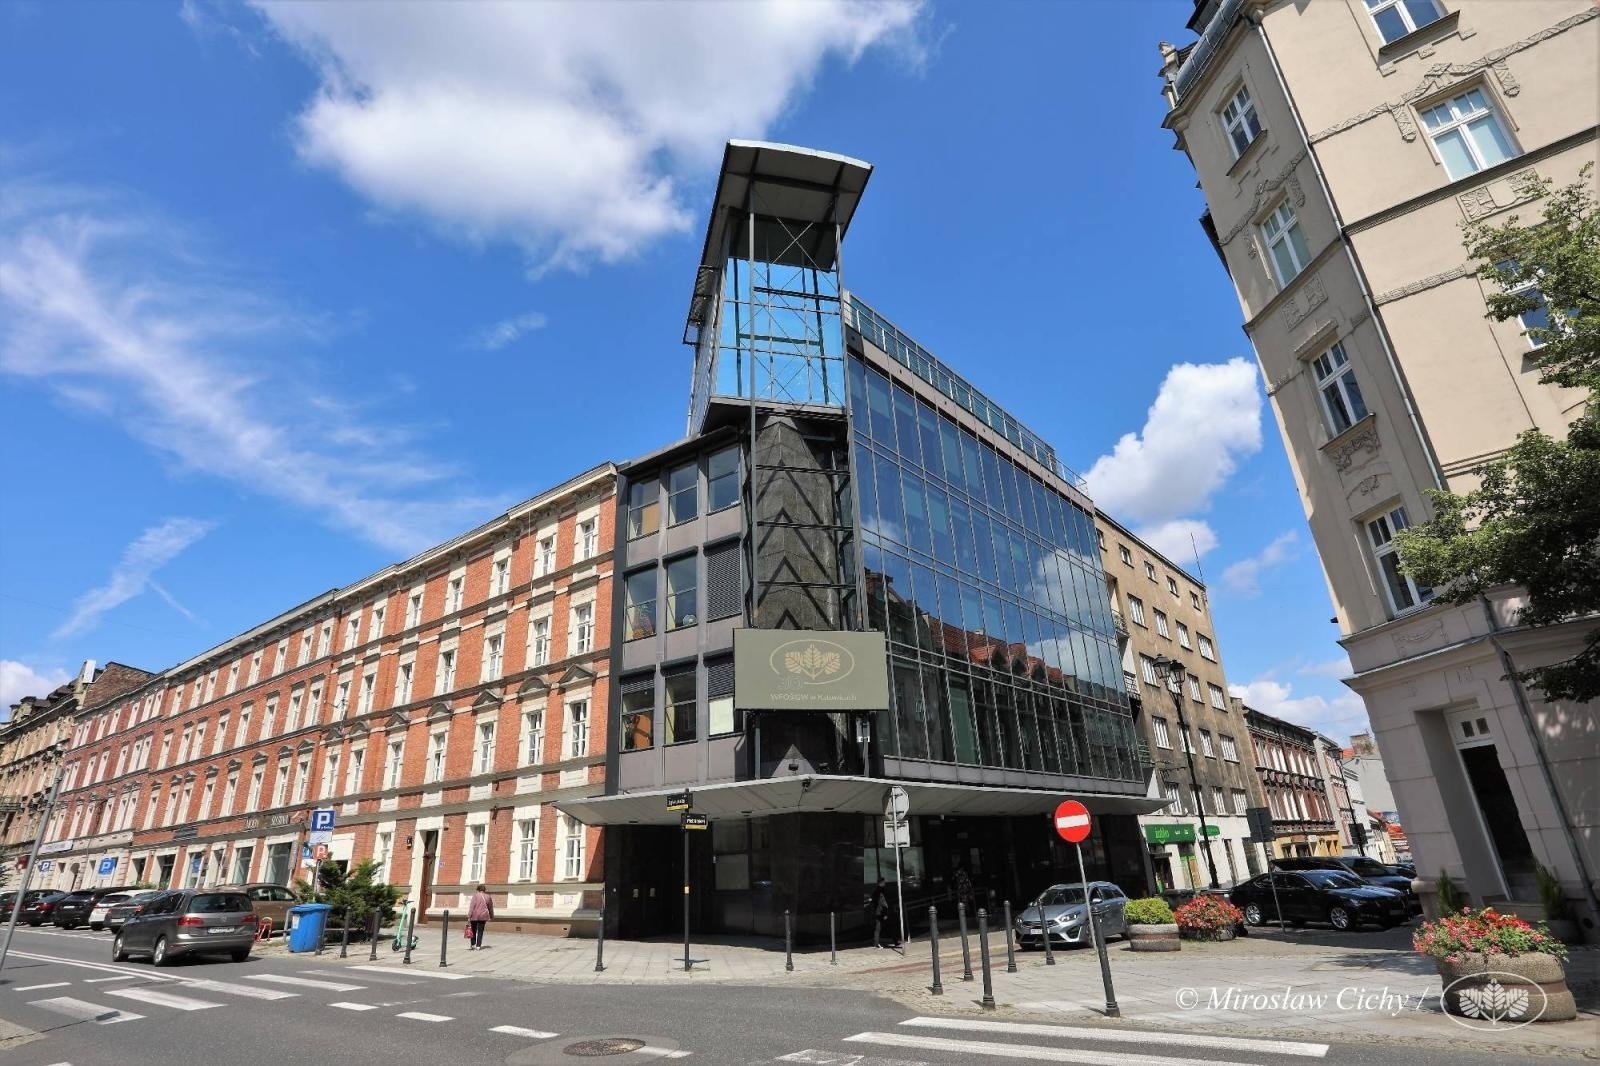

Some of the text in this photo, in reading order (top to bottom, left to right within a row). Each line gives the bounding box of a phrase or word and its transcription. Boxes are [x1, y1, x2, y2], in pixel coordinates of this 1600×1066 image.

[316, 812, 331, 829] P
[316, 845, 326, 859] P
[101, 861, 112, 872] P
